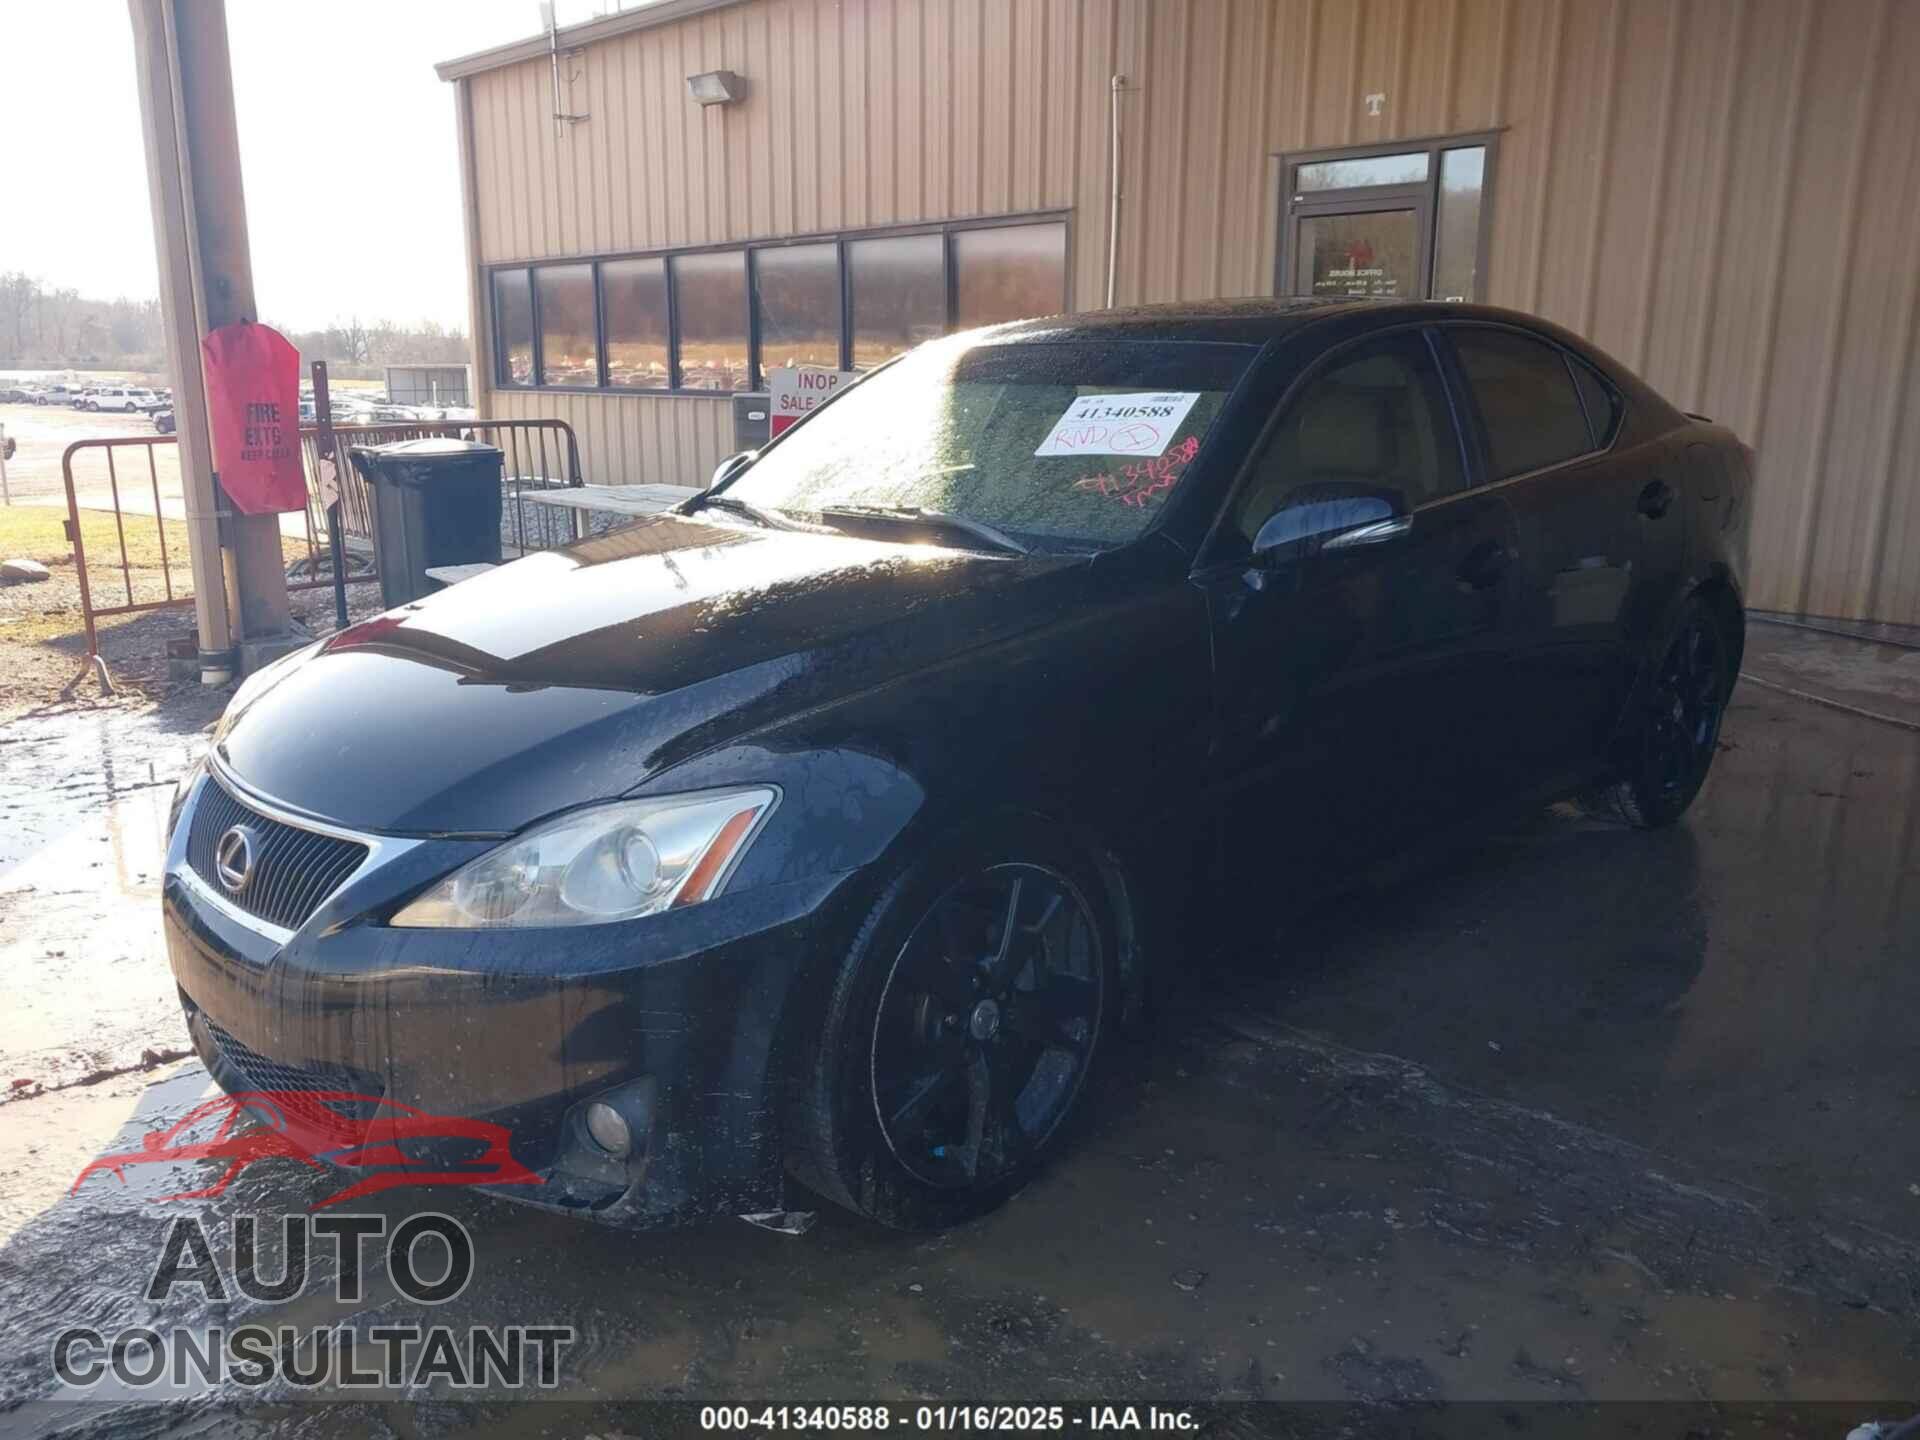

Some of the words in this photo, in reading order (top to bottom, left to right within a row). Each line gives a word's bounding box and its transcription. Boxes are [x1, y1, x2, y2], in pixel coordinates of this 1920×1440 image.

[1365, 93, 1385, 116] T
[798, 373, 838, 390] INOP
[780, 394, 814, 410] SALE
[247, 402, 281, 423] FIRE
[1076, 405, 1175, 420] 41340588
